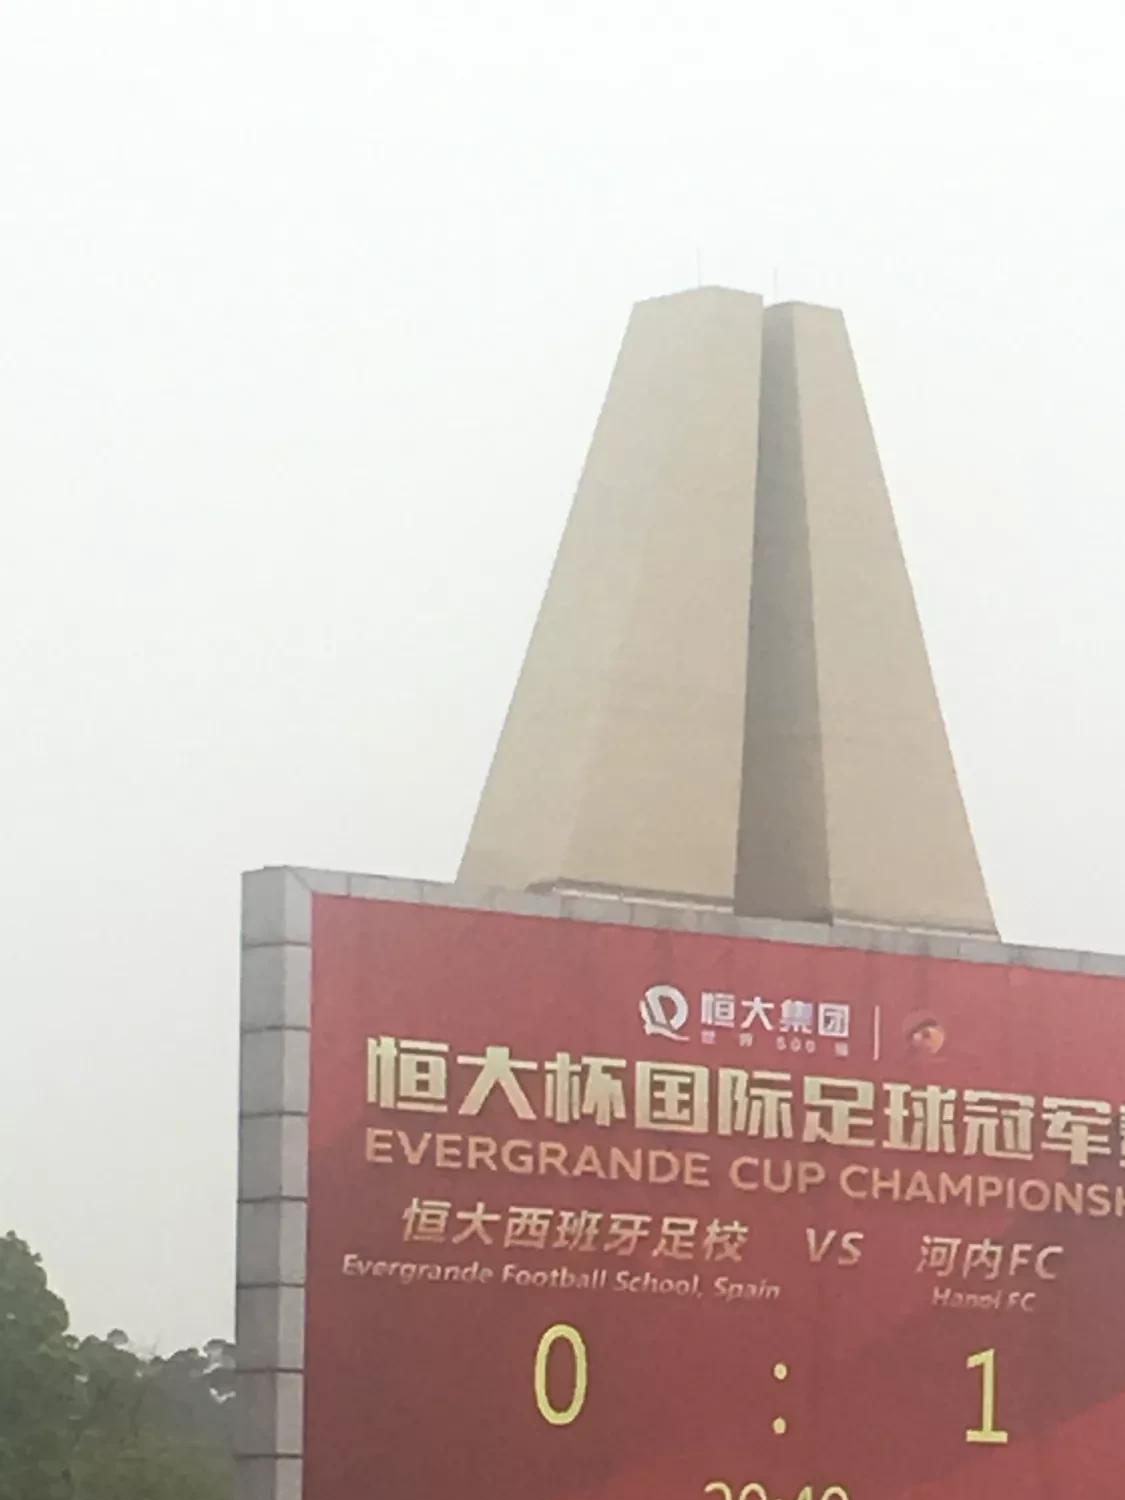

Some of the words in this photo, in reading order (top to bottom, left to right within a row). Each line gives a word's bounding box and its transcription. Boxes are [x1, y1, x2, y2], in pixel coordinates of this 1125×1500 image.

[701, 992, 850, 1037] 恒大集团
[365, 1127, 711, 1188] EVERGRANDE
[728, 1156, 826, 1194] CUP
[402, 1196, 750, 1263] 恒大西班牙足校
[804, 1227, 865, 1266] VS
[915, 1234, 1064, 1280] 河内FC
[342, 1253, 494, 1285] Evergrande
[501, 1264, 607, 1290] Football
[713, 1276, 781, 1302] Spain
[1006, 1291, 1037, 1313] FC
[534, 1323, 589, 1426] 0
[965, 1347, 1009, 1443] 1
